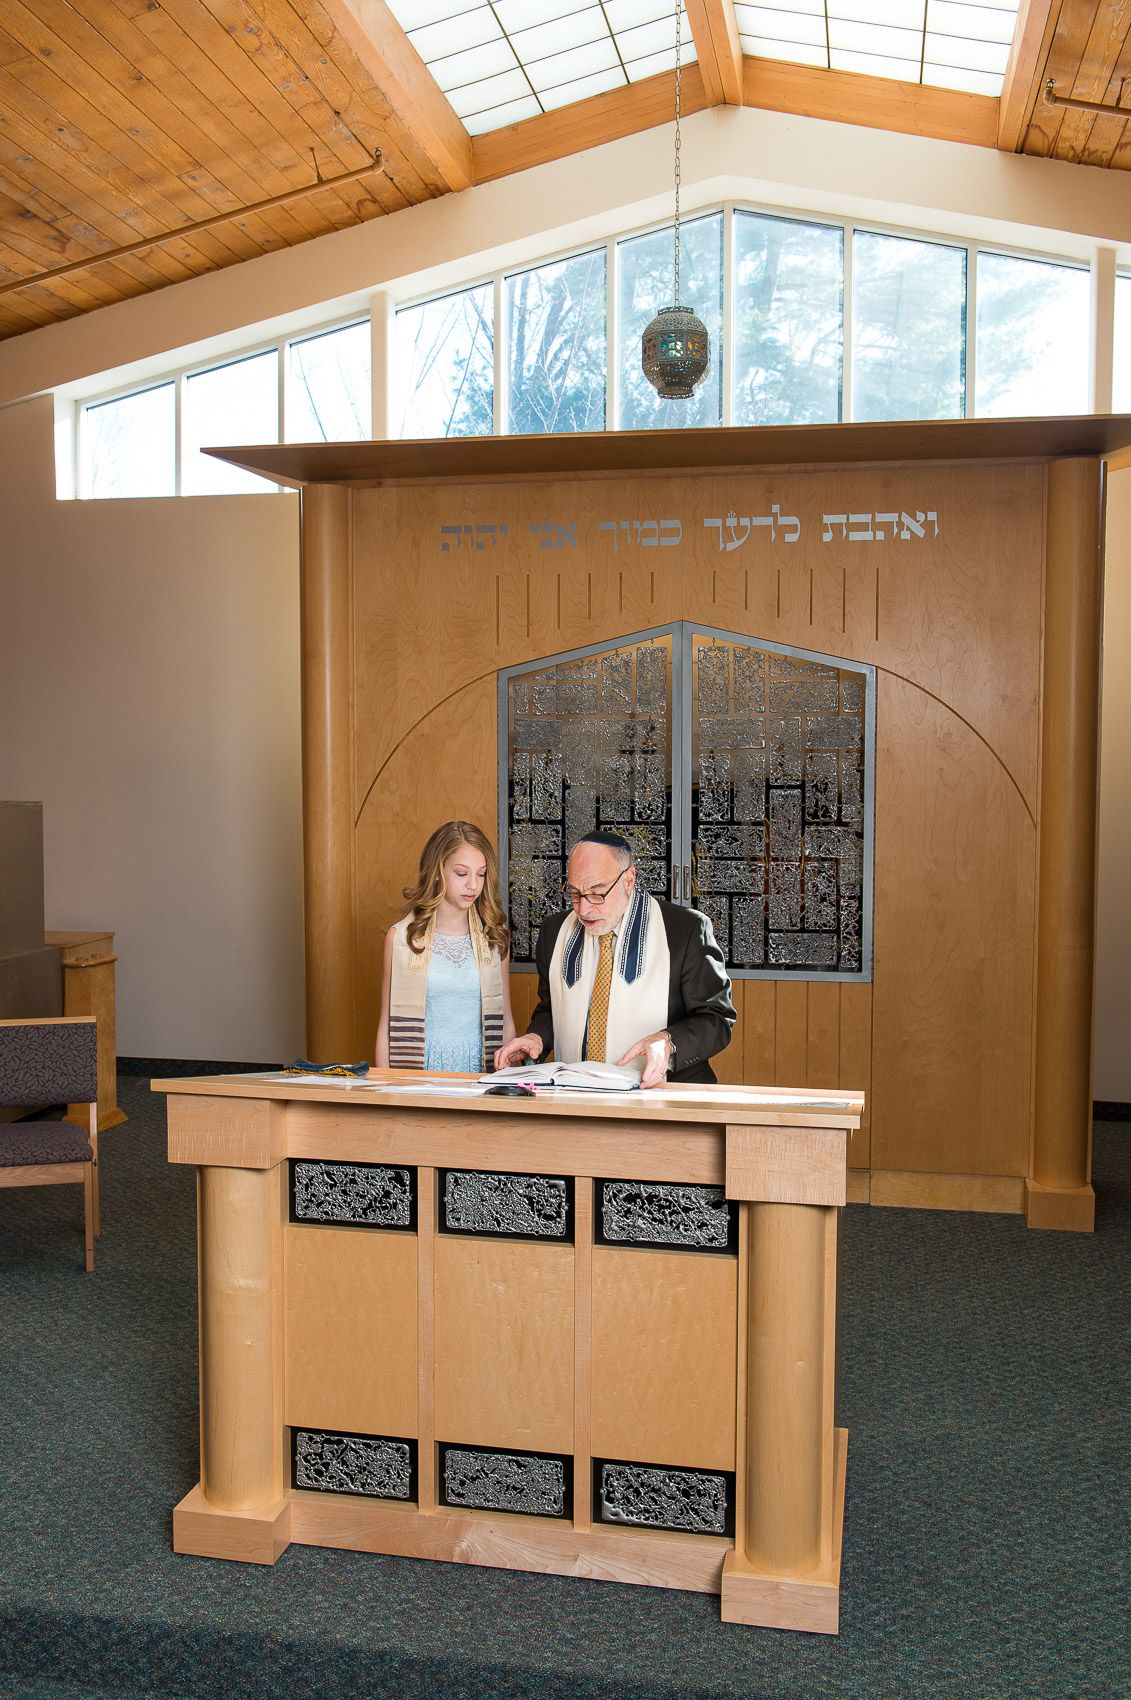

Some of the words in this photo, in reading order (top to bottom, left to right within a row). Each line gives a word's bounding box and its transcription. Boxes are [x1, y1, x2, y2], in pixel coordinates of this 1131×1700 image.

[441, 524, 508, 551] יהוה
[529, 519, 577, 549] אני
[598, 519, 682, 555] כמוך
[822, 510, 939, 542] ואהבת
